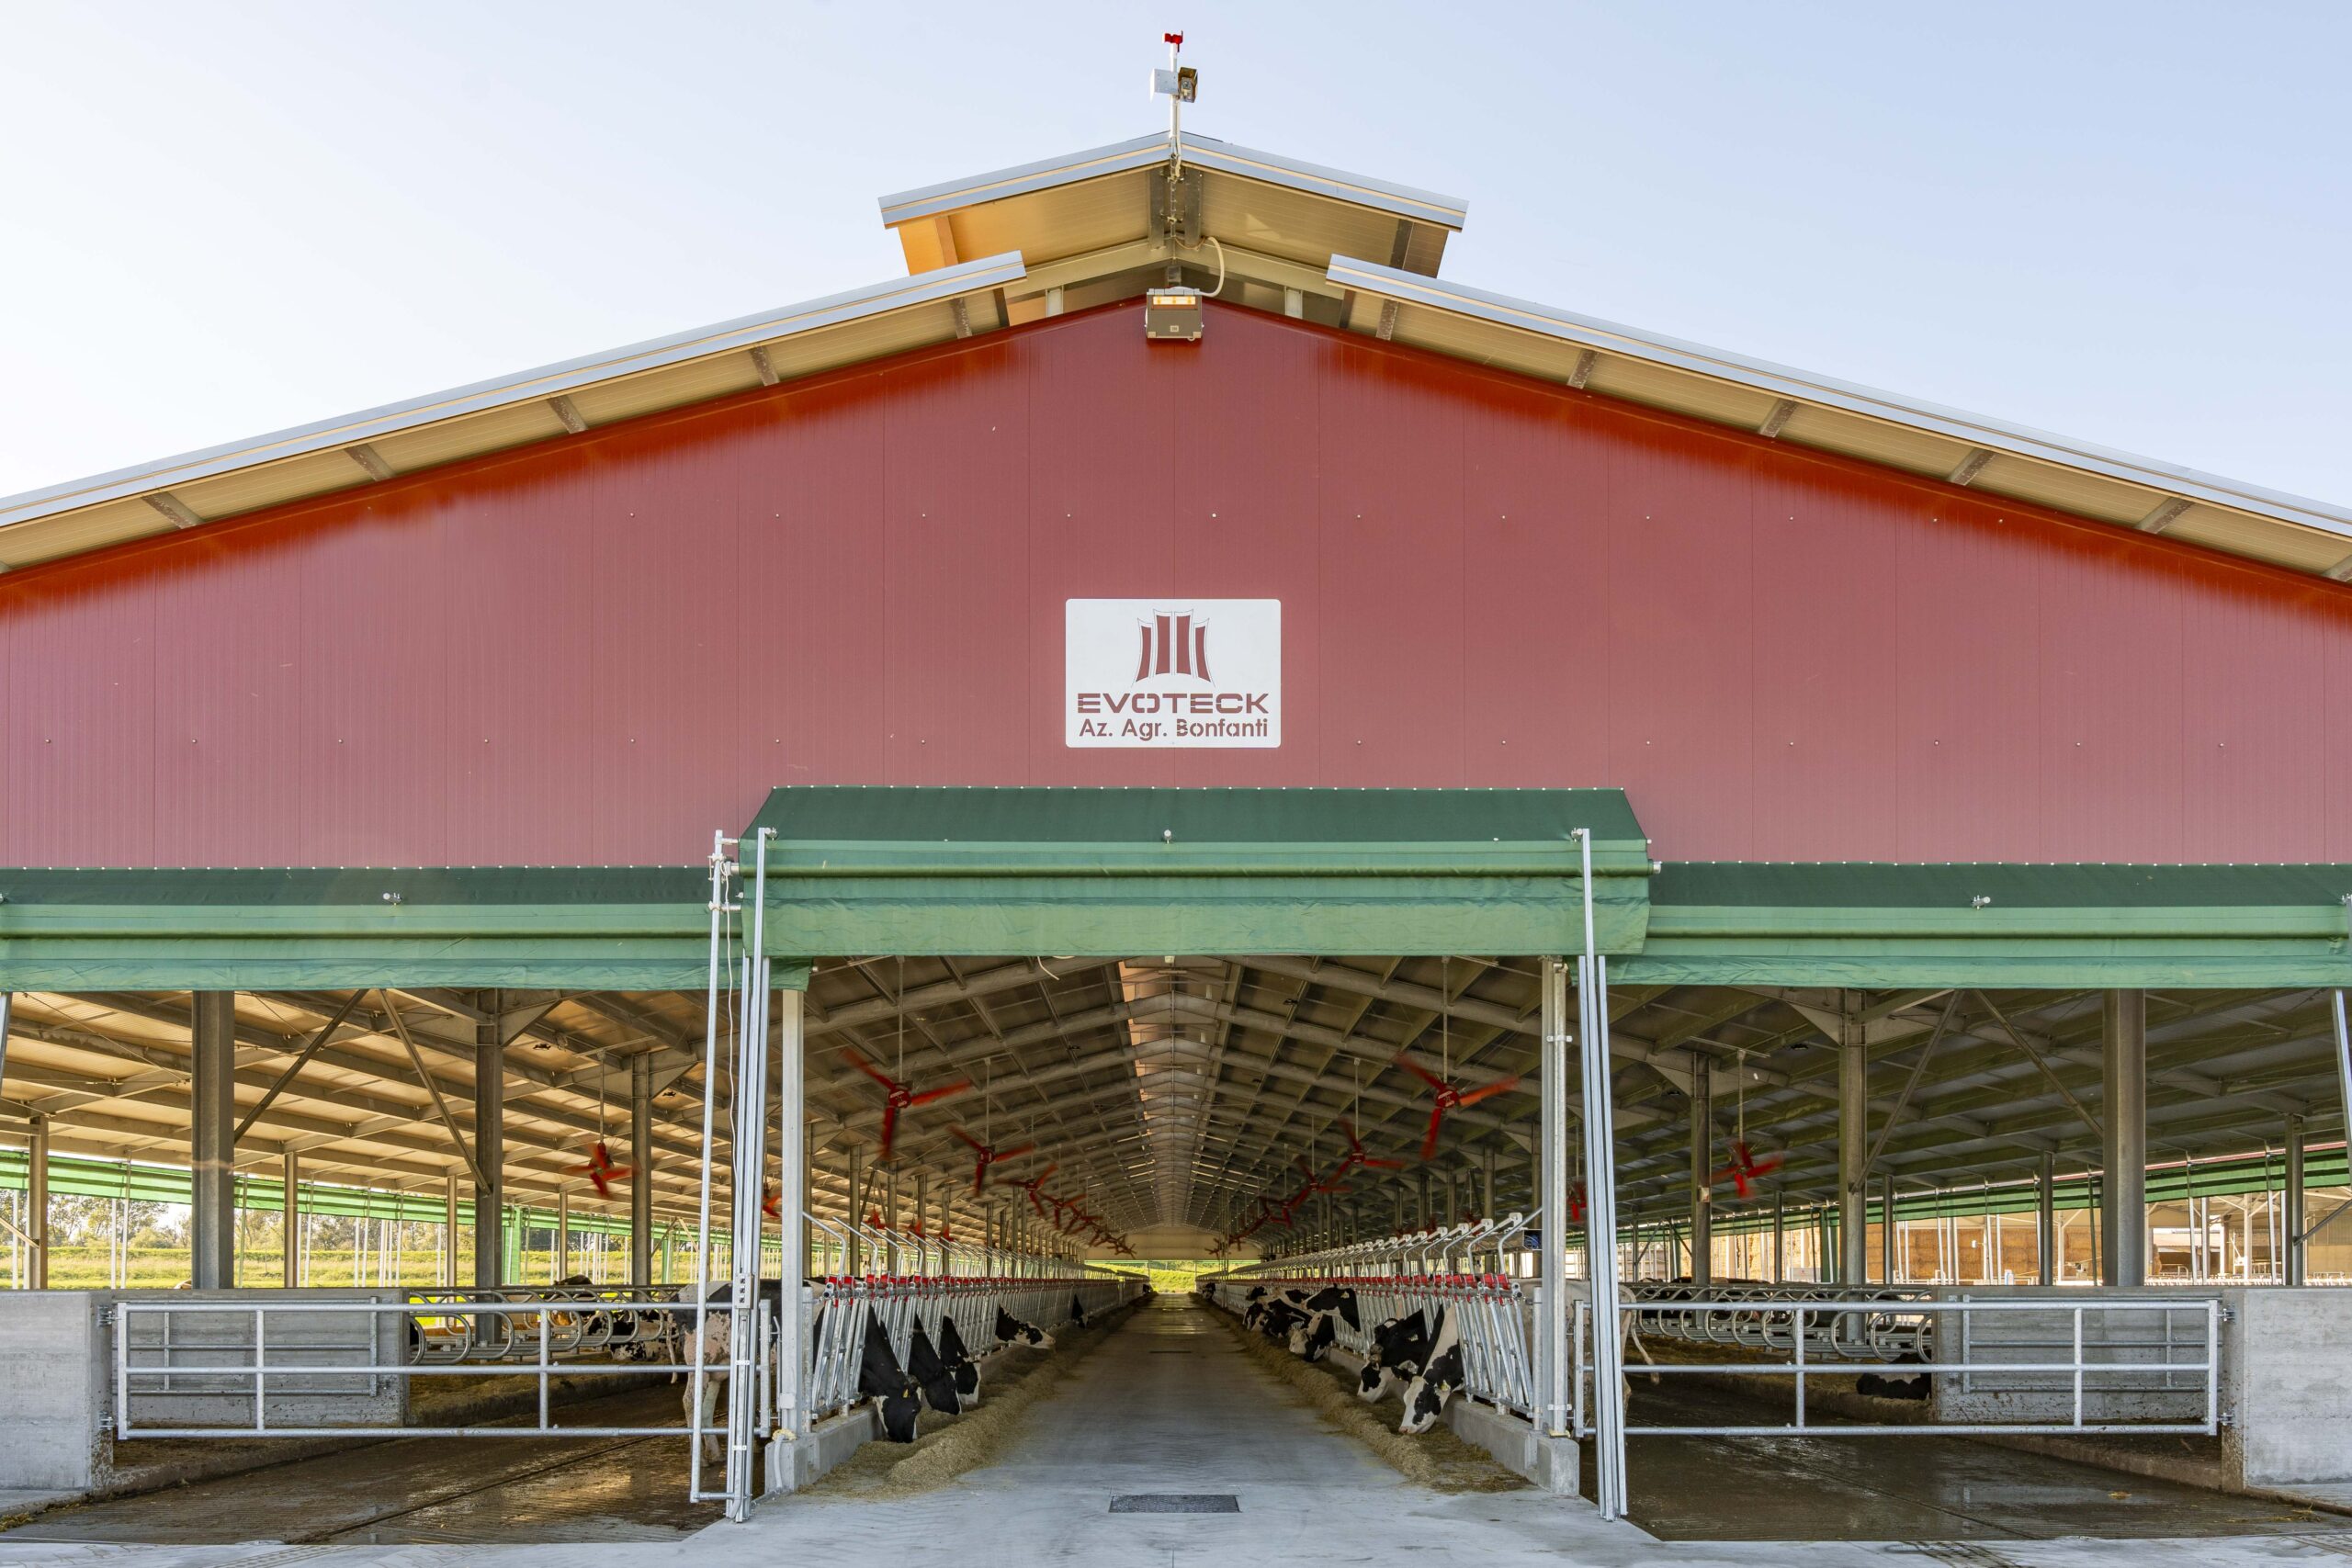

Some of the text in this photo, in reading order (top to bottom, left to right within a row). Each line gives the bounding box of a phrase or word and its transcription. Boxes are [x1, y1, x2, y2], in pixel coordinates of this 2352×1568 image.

[1078, 694, 1269, 714] EVOTECK
[1080, 718, 1268, 741] Az. Agr. Bonfanti
